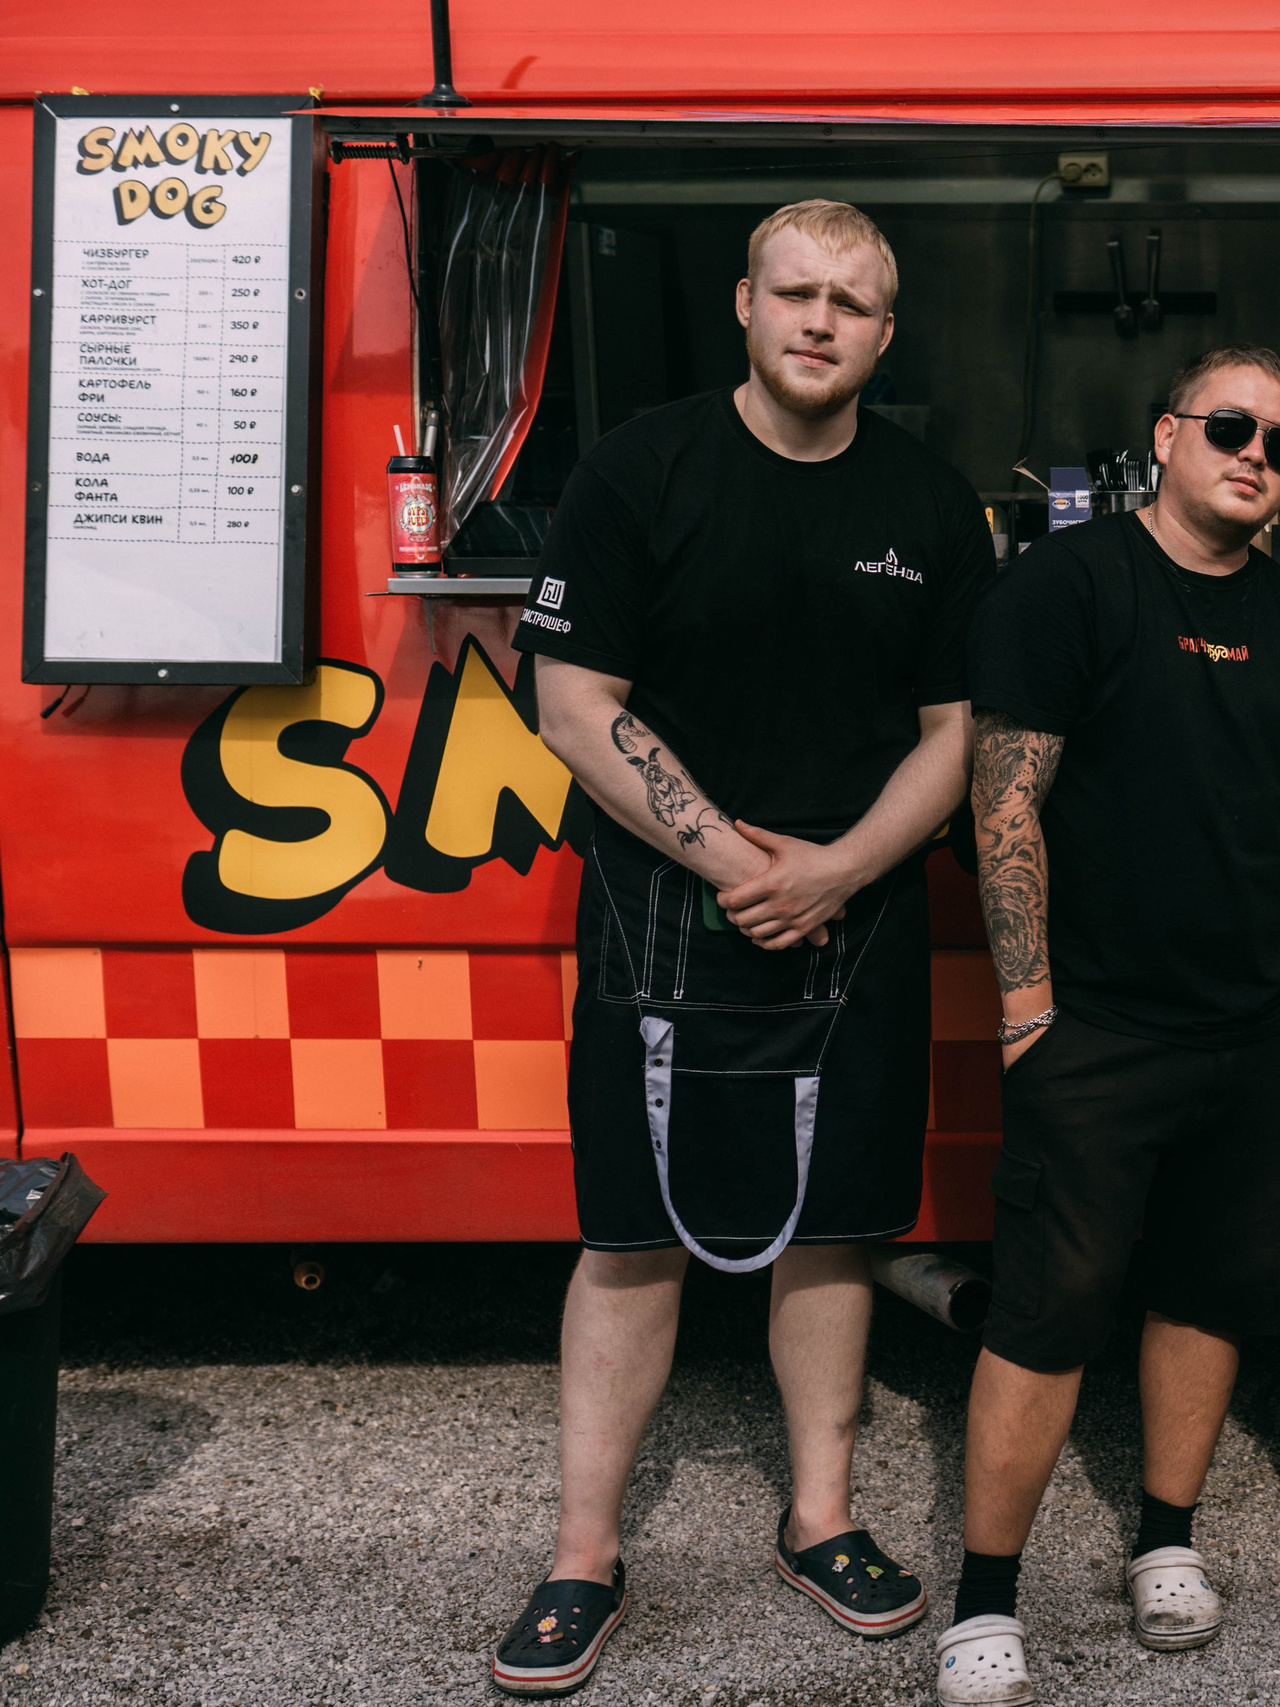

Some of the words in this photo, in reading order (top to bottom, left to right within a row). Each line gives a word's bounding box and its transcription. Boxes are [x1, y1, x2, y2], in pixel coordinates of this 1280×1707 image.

[77, 122, 272, 177] SMOKY
[113, 177, 227, 229] DOG
[82, 248, 149, 260] ЧИЗБУРГЕР
[232, 255, 251, 265] 420
[80, 279, 133, 291] ХОТ-ДОГ
[231, 288, 250, 298] 250
[80, 314, 157, 325] КАРРИВУРСТ
[230, 321, 250, 331] 350
[79, 344, 132, 355] СЫРНЫЕ
[79, 355, 137, 367] ПАЛОЧКИ
[229, 354, 248, 364] 290
[78, 379, 151, 390] КАРТОФЕЛЬ
[78, 392, 105, 403] ФРИ
[230, 387, 249, 397] 160
[77, 412, 121, 423] СОУСЫ:
[233, 420, 247, 430] 50
[76, 452, 110, 464] ВОДА
[75, 477, 109, 488] КОЛА
[227, 486, 244, 496] 100
[74, 491, 118, 503] ФАНТА
[73, 513, 127, 525] ДЖИПСИ
[131, 514, 163, 526] КВИН
[227, 520, 242, 529] 280
[854, 560, 923, 584] ЛЕГЕНДА
[1227, 645, 1250, 662] МАЙ
